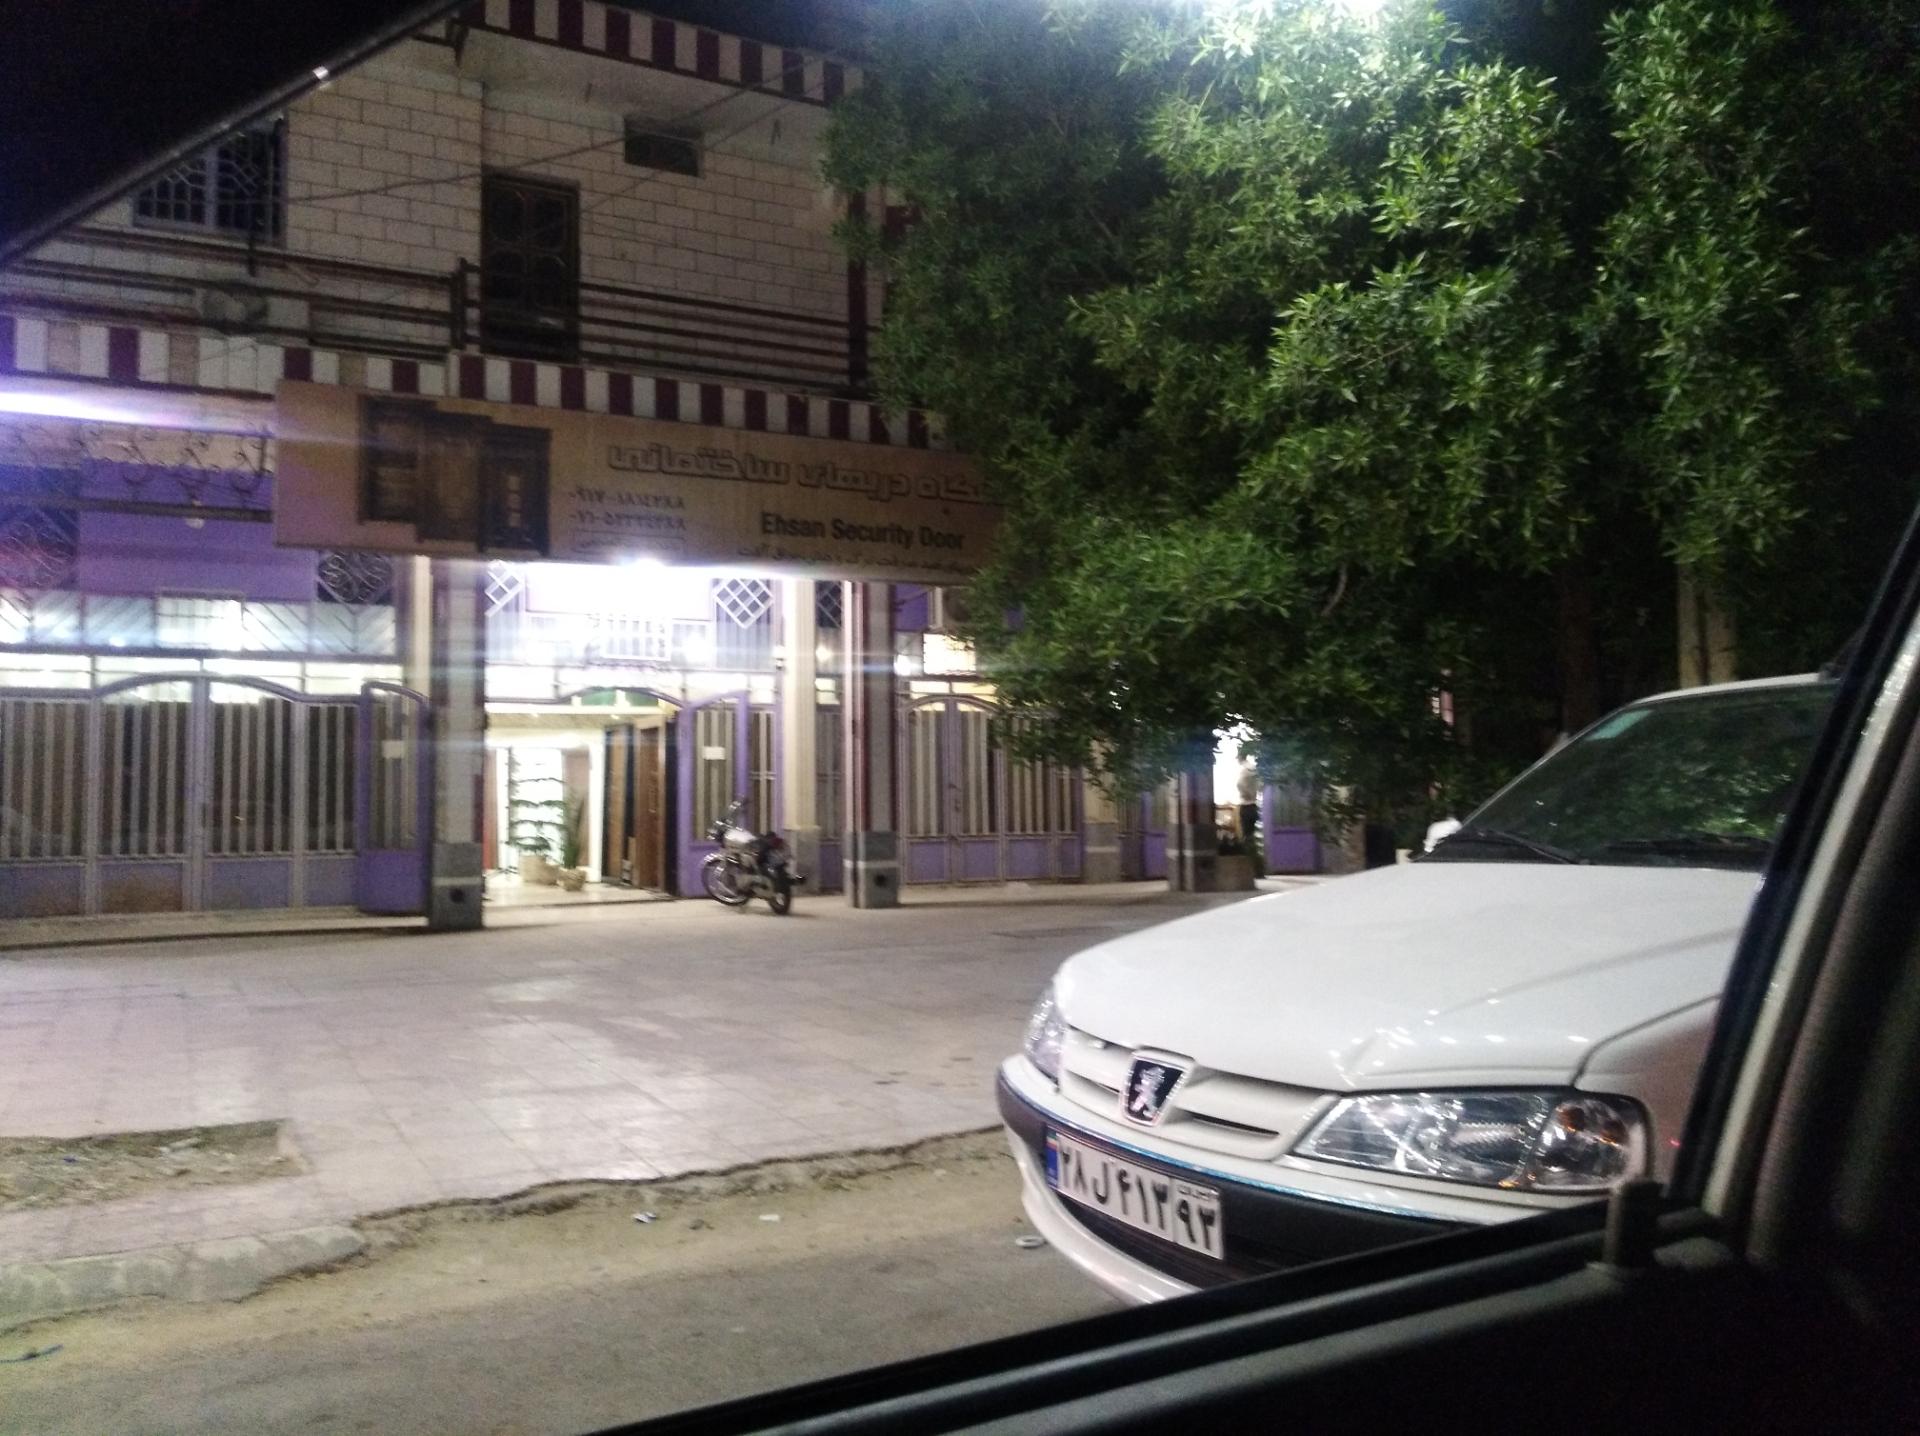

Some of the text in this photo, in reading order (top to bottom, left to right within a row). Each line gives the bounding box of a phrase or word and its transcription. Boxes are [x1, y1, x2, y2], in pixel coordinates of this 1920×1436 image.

[761, 511, 966, 550] Ehsan Security Door
